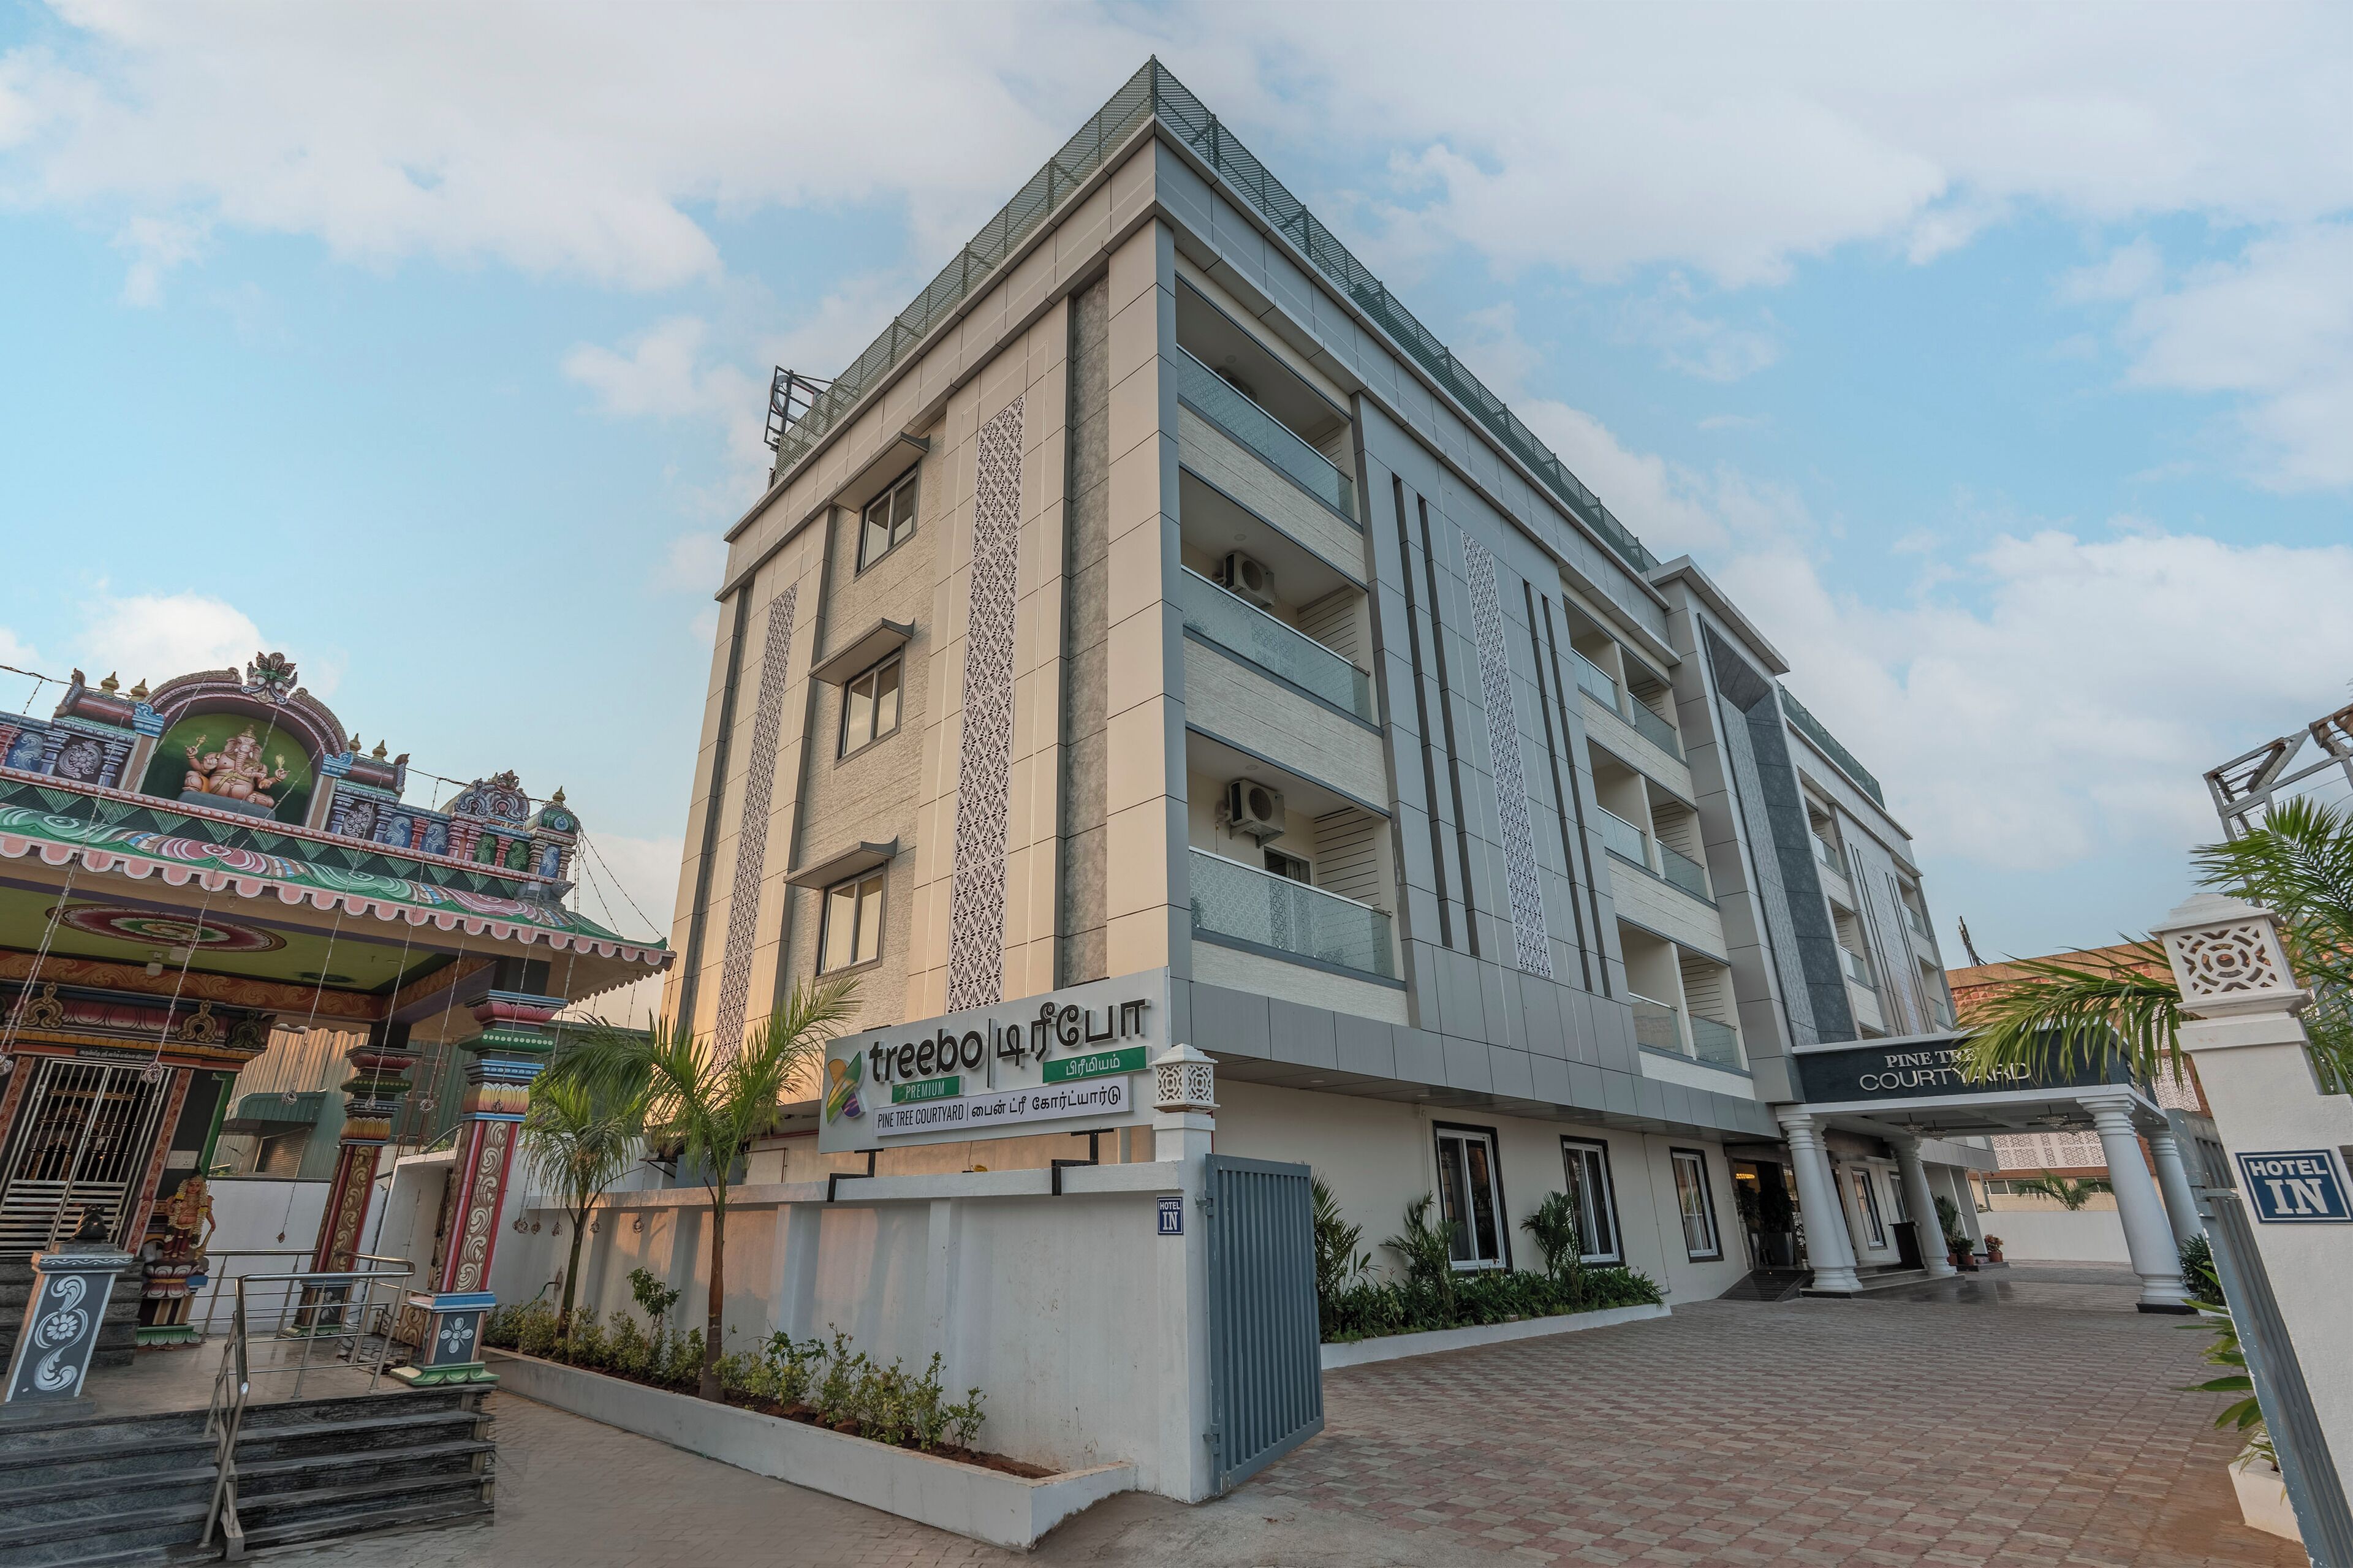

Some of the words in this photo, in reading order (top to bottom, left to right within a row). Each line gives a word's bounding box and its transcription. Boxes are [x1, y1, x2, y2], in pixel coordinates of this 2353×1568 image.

[996, 998, 1148, 1067] டிரீபோ
[869, 1028, 985, 1083] treebo
[1066, 1053, 1121, 1077] பிரீமியம்
[1884, 1051, 1931, 1068] PINE
[905, 1080, 945, 1100] PREMIUM
[971, 1099, 1006, 1118] பைன்
[1032, 1085, 1121, 1111] கோர்ட்யார்டு
[877, 1111, 894, 1129] PINE
[896, 1109, 914, 1127] TREE
[915, 1104, 964, 1124] COURTYARD
[2248, 1159, 2328, 1176] HOTEL
[1159, 1202, 1180, 1210] HOTEL
[2264, 1178, 2329, 1214] IN
[1162, 1211, 1178, 1230] IN
